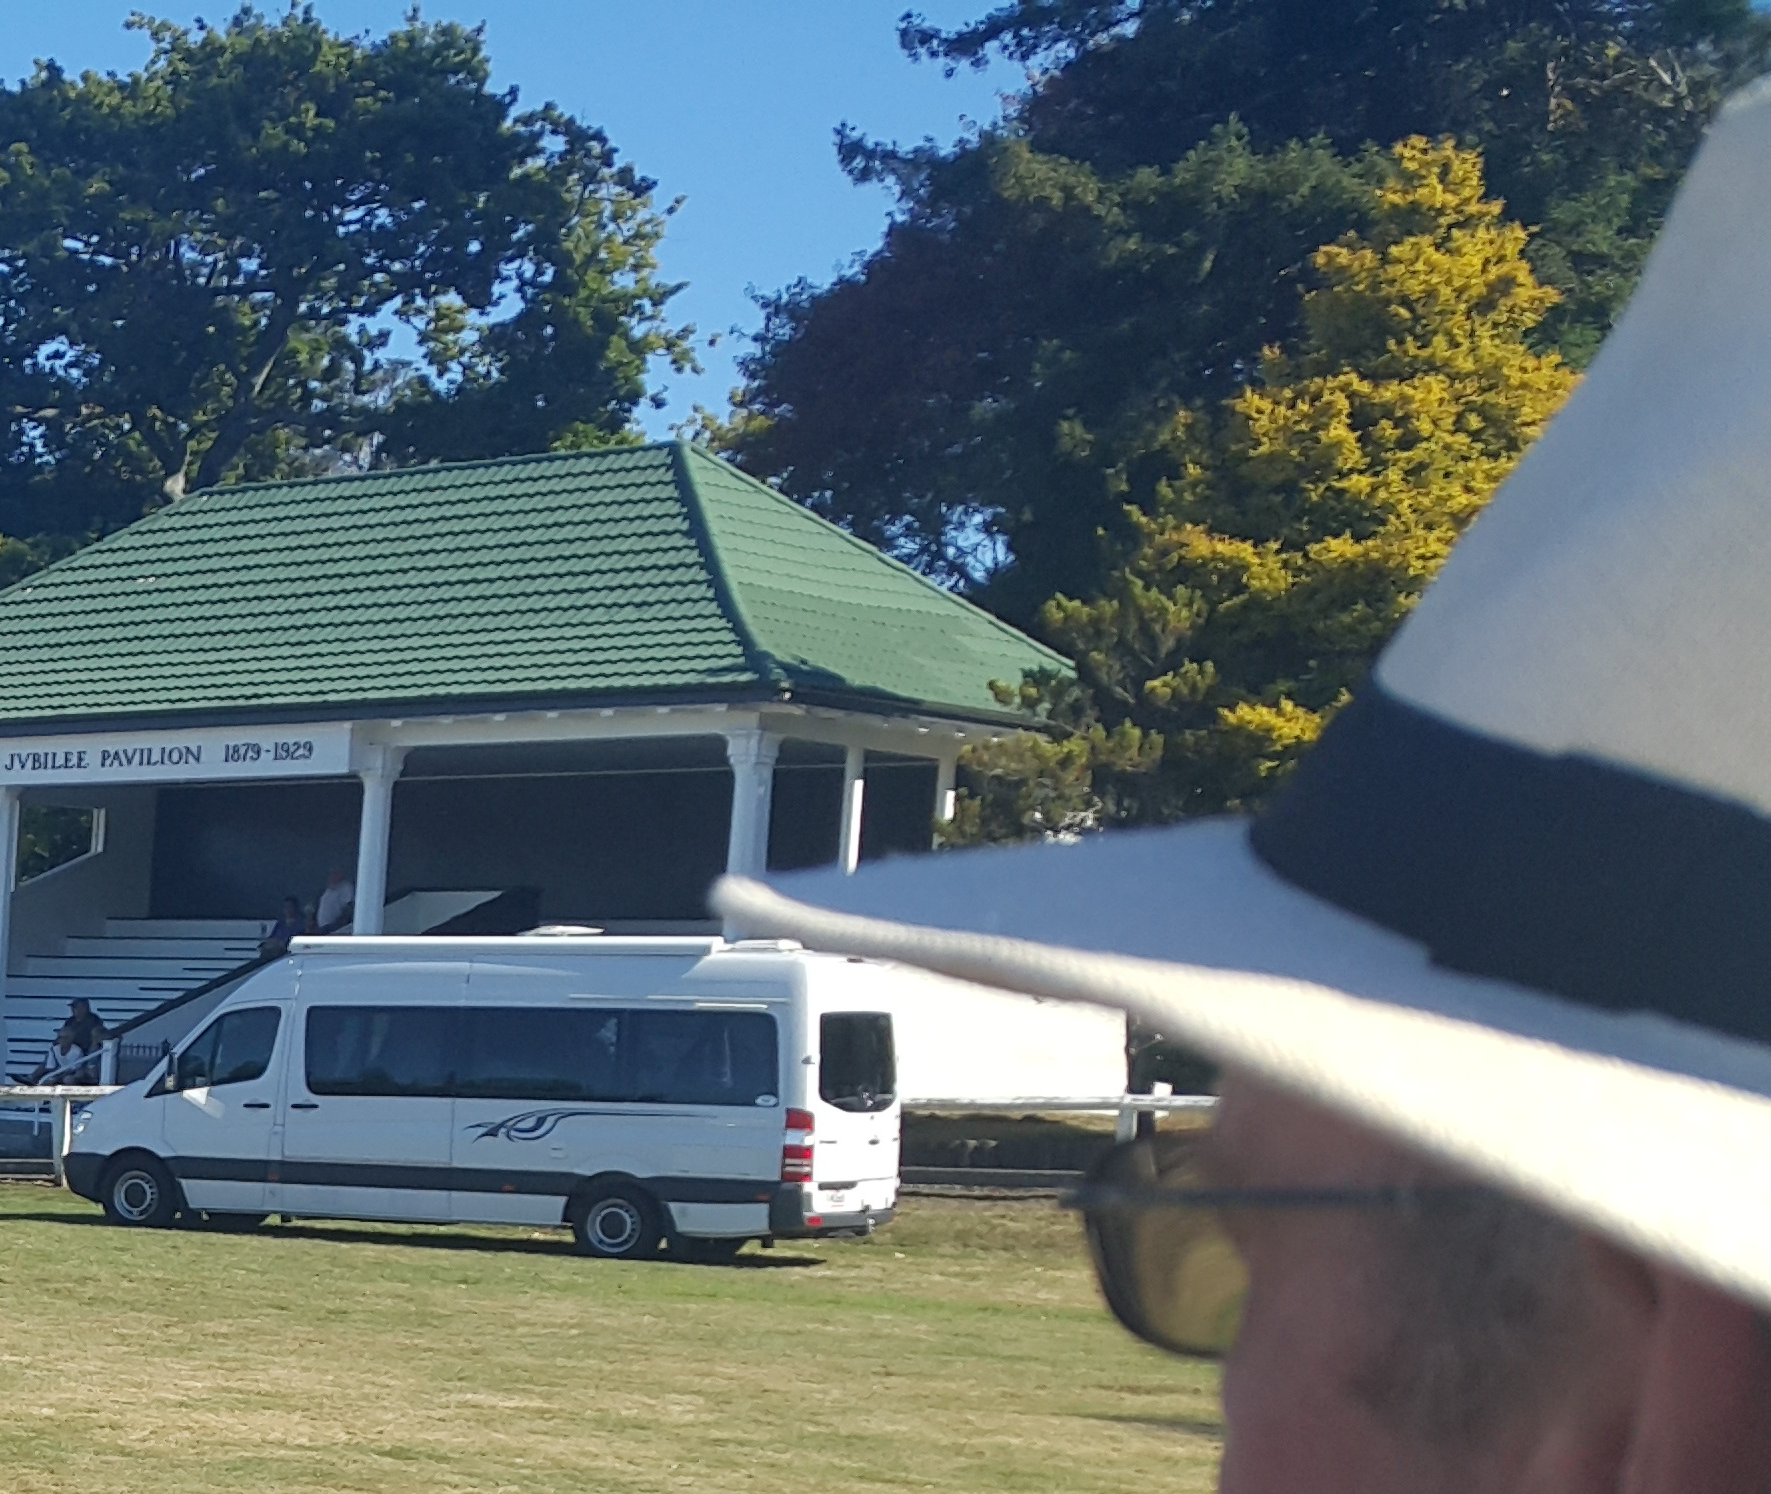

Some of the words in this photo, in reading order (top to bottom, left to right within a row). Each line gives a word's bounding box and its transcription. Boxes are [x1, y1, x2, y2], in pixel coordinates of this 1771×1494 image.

[4, 749, 89, 772] JVBILEE
[100, 744, 203, 769] PAVILION
[223, 740, 314, 763] 1879-1929
